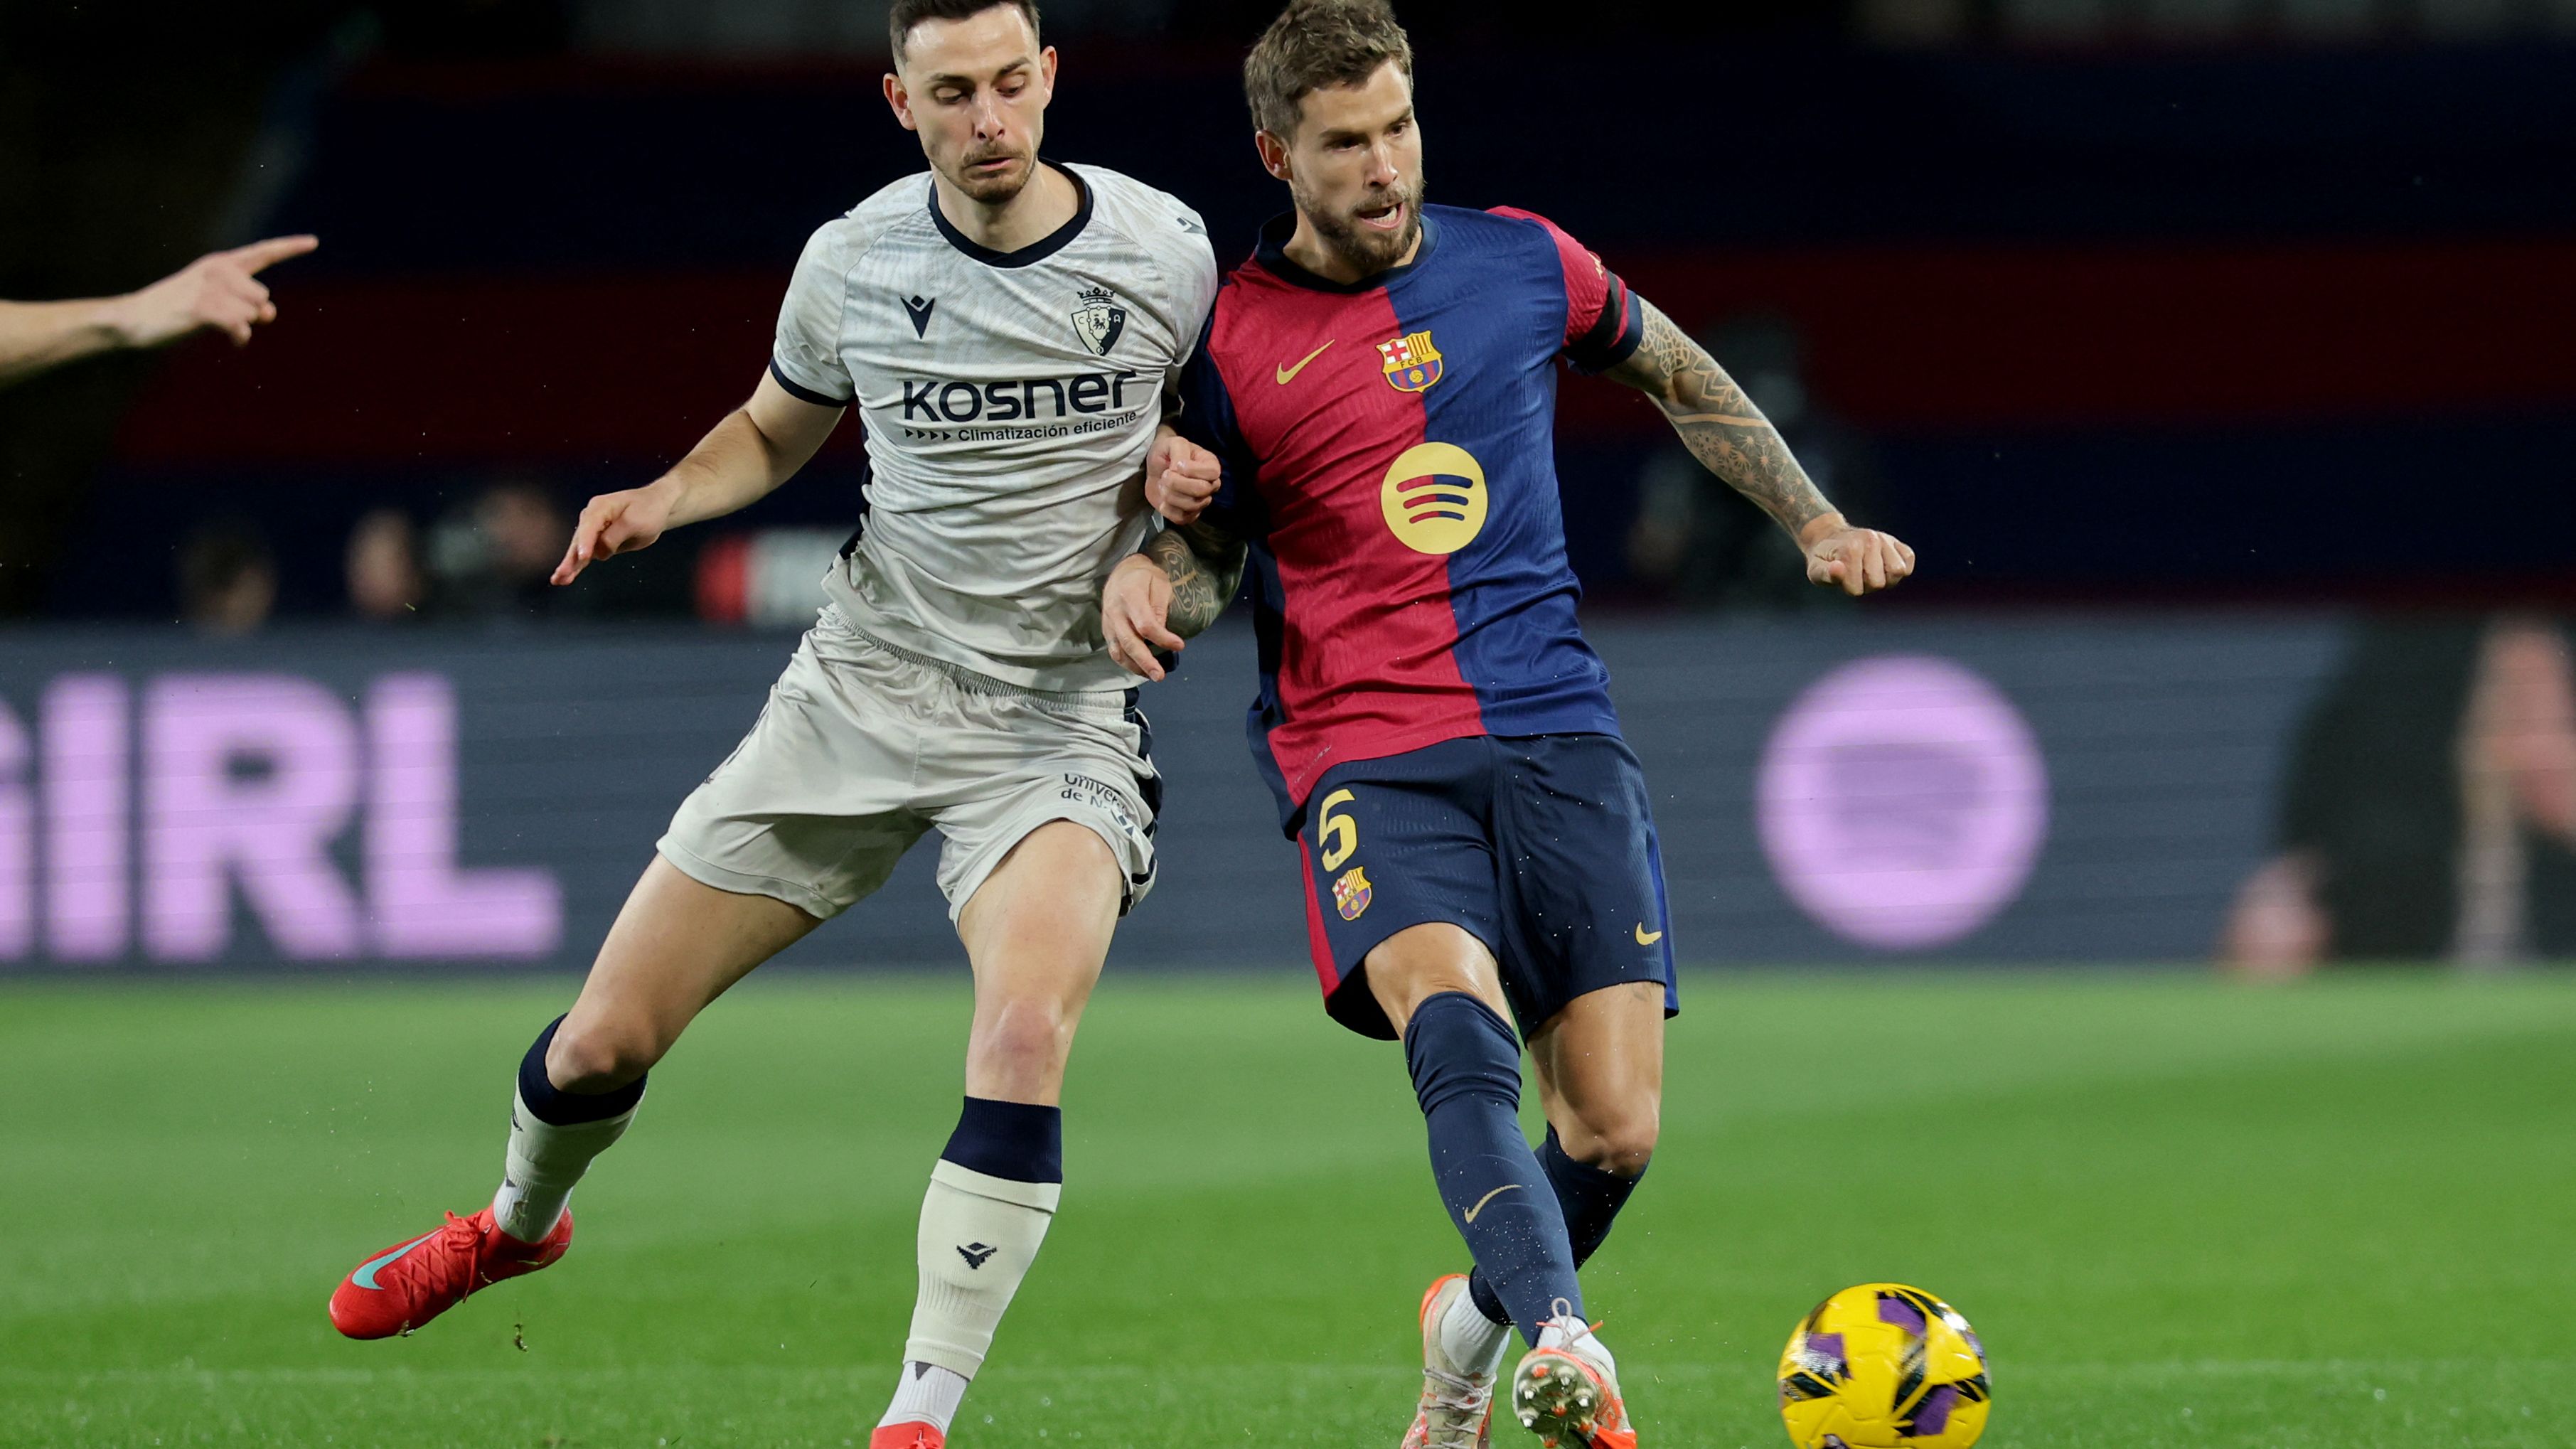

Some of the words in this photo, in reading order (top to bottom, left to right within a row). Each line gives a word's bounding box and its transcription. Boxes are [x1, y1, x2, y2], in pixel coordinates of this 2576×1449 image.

[1401, 357, 1423, 368] FCB
[958, 426, 1069, 442] Climatización
[1074, 410, 1137, 435] eficiente
[1061, 788, 1083, 801] de
[1089, 795, 1107, 809] N
[1319, 788, 1357, 872] 5
